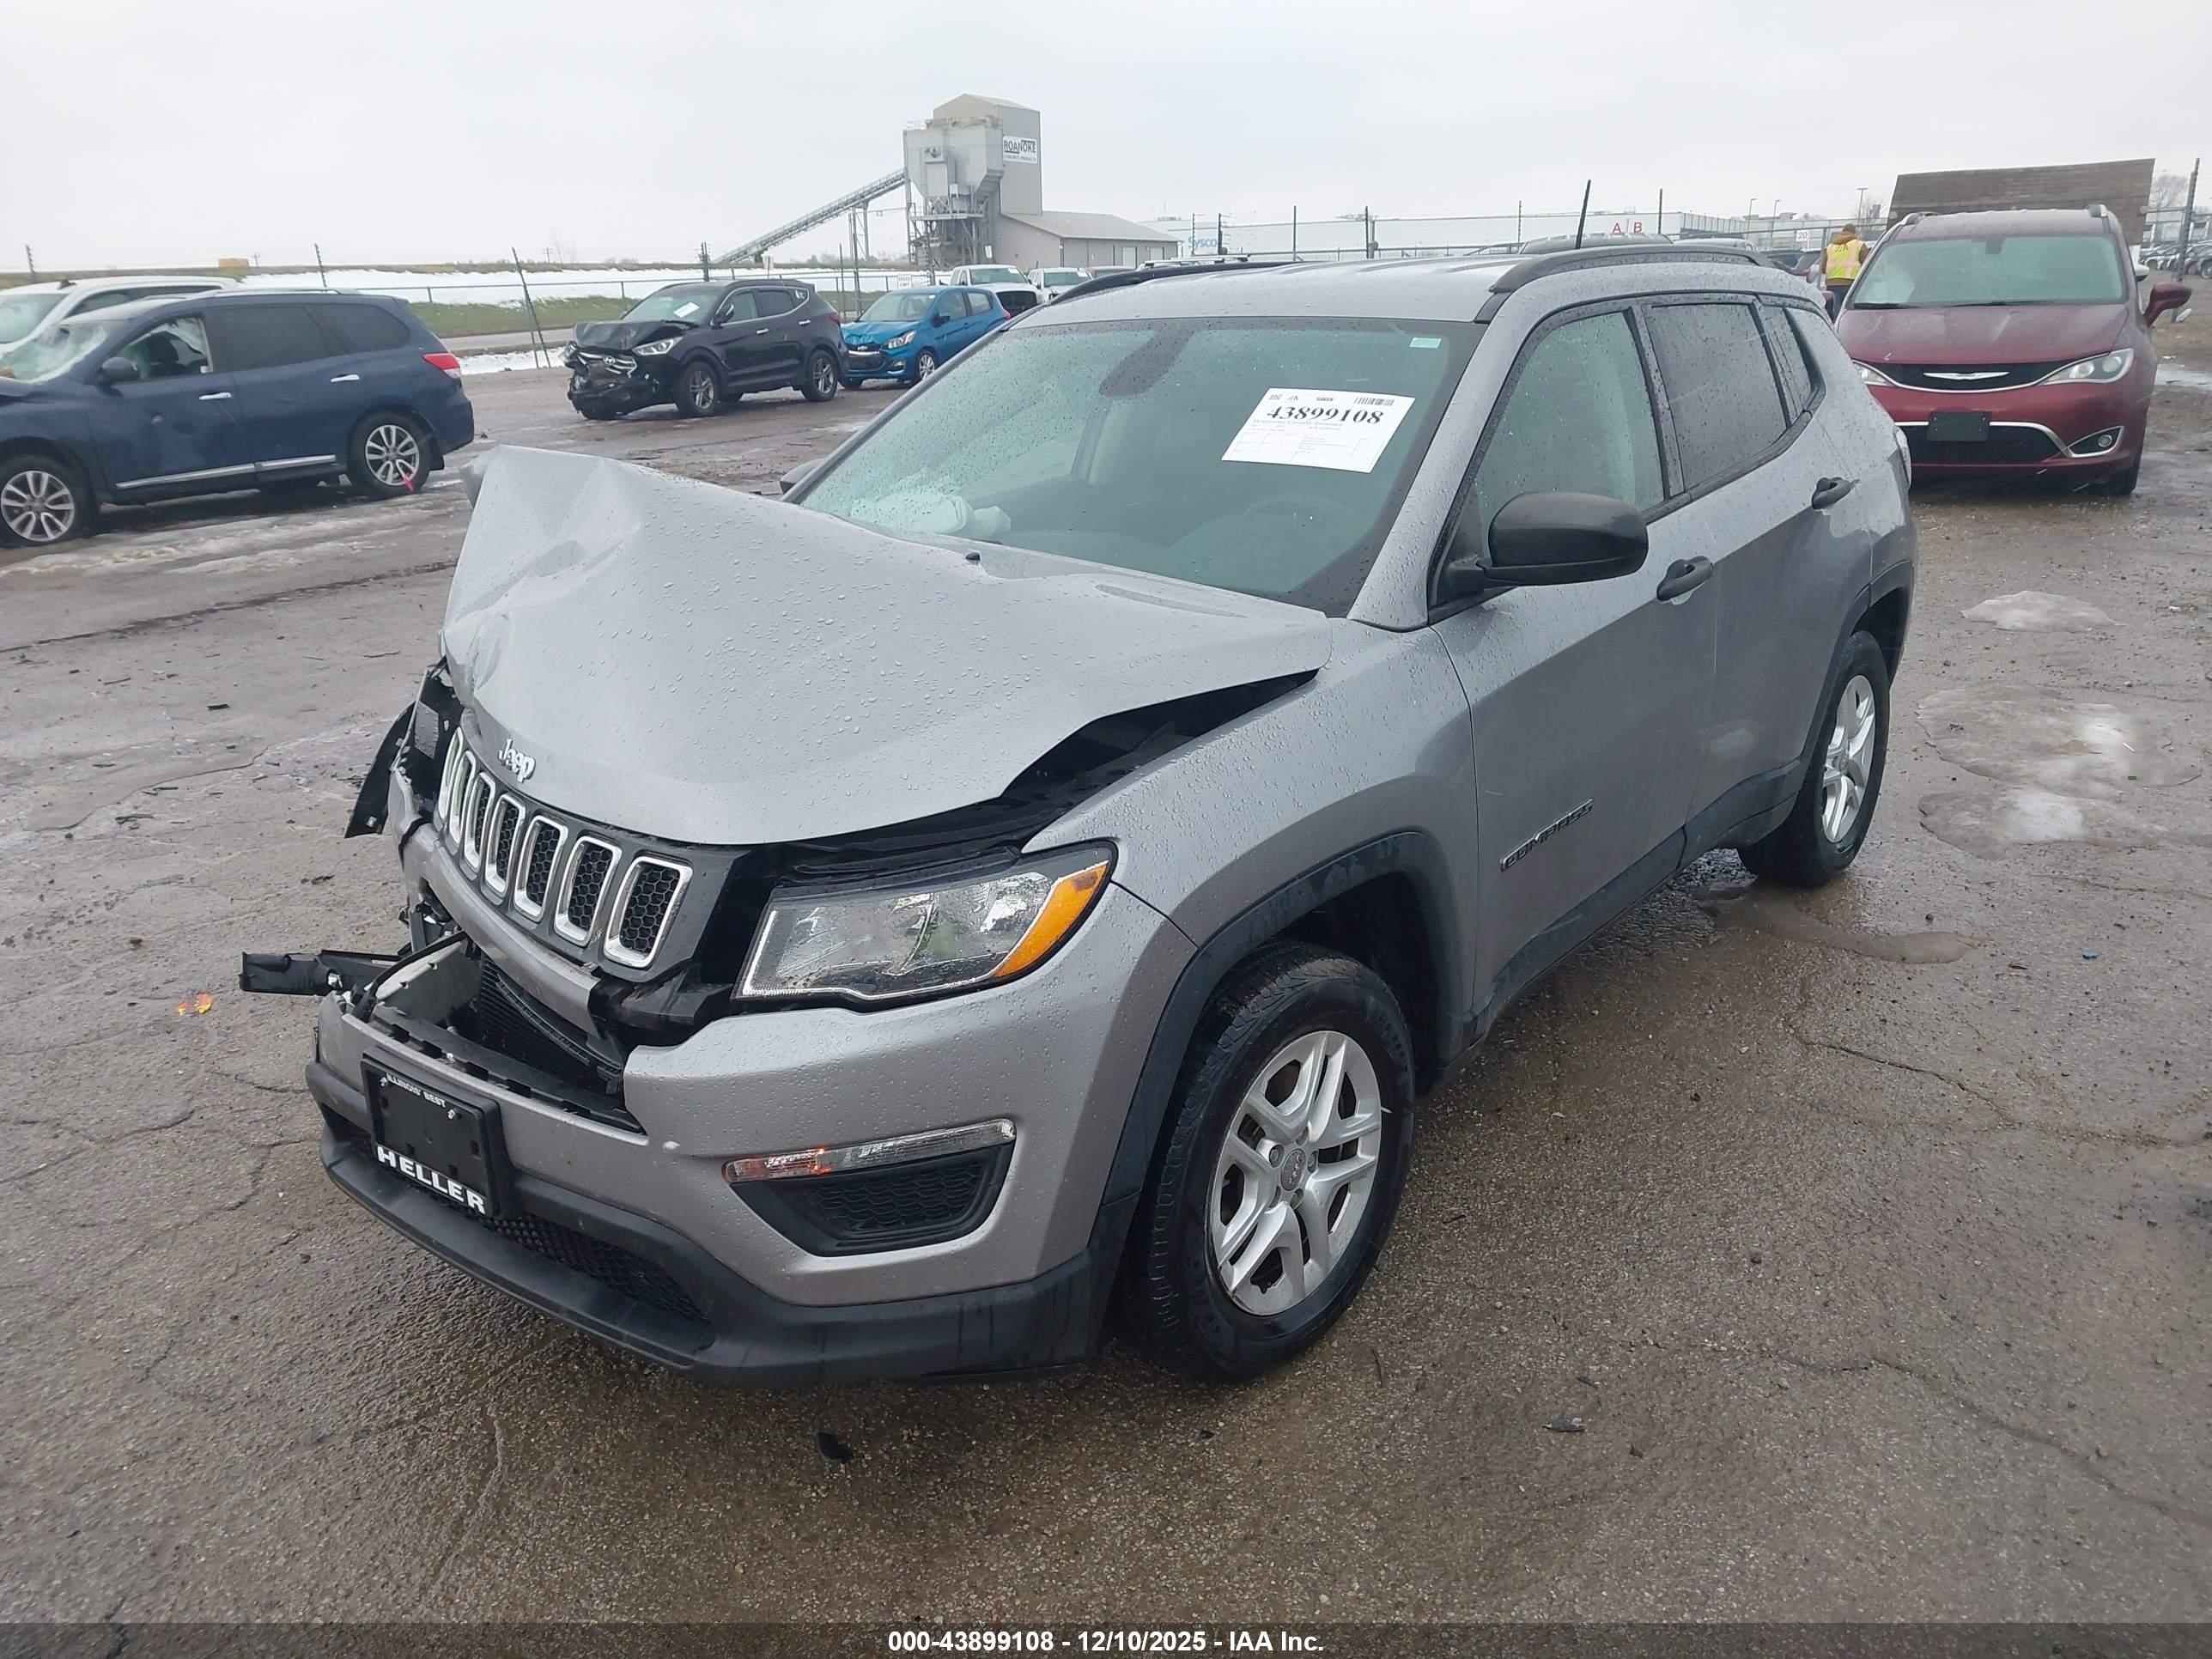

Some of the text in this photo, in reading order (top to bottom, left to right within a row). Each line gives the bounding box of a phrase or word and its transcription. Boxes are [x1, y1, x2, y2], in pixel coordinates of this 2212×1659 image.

[1004, 140, 1036, 154] ROANOKE
[1612, 222, 1622, 234] A
[1633, 222, 1643, 233] B
[1188, 236, 1218, 250] Sysco
[1267, 405, 1384, 424] 43899108
[499, 738, 536, 783] Jeep
[1500, 798, 1594, 872] COMPASS
[423, 1091, 447, 1108] BEST
[377, 1146, 486, 1215] HELLER
